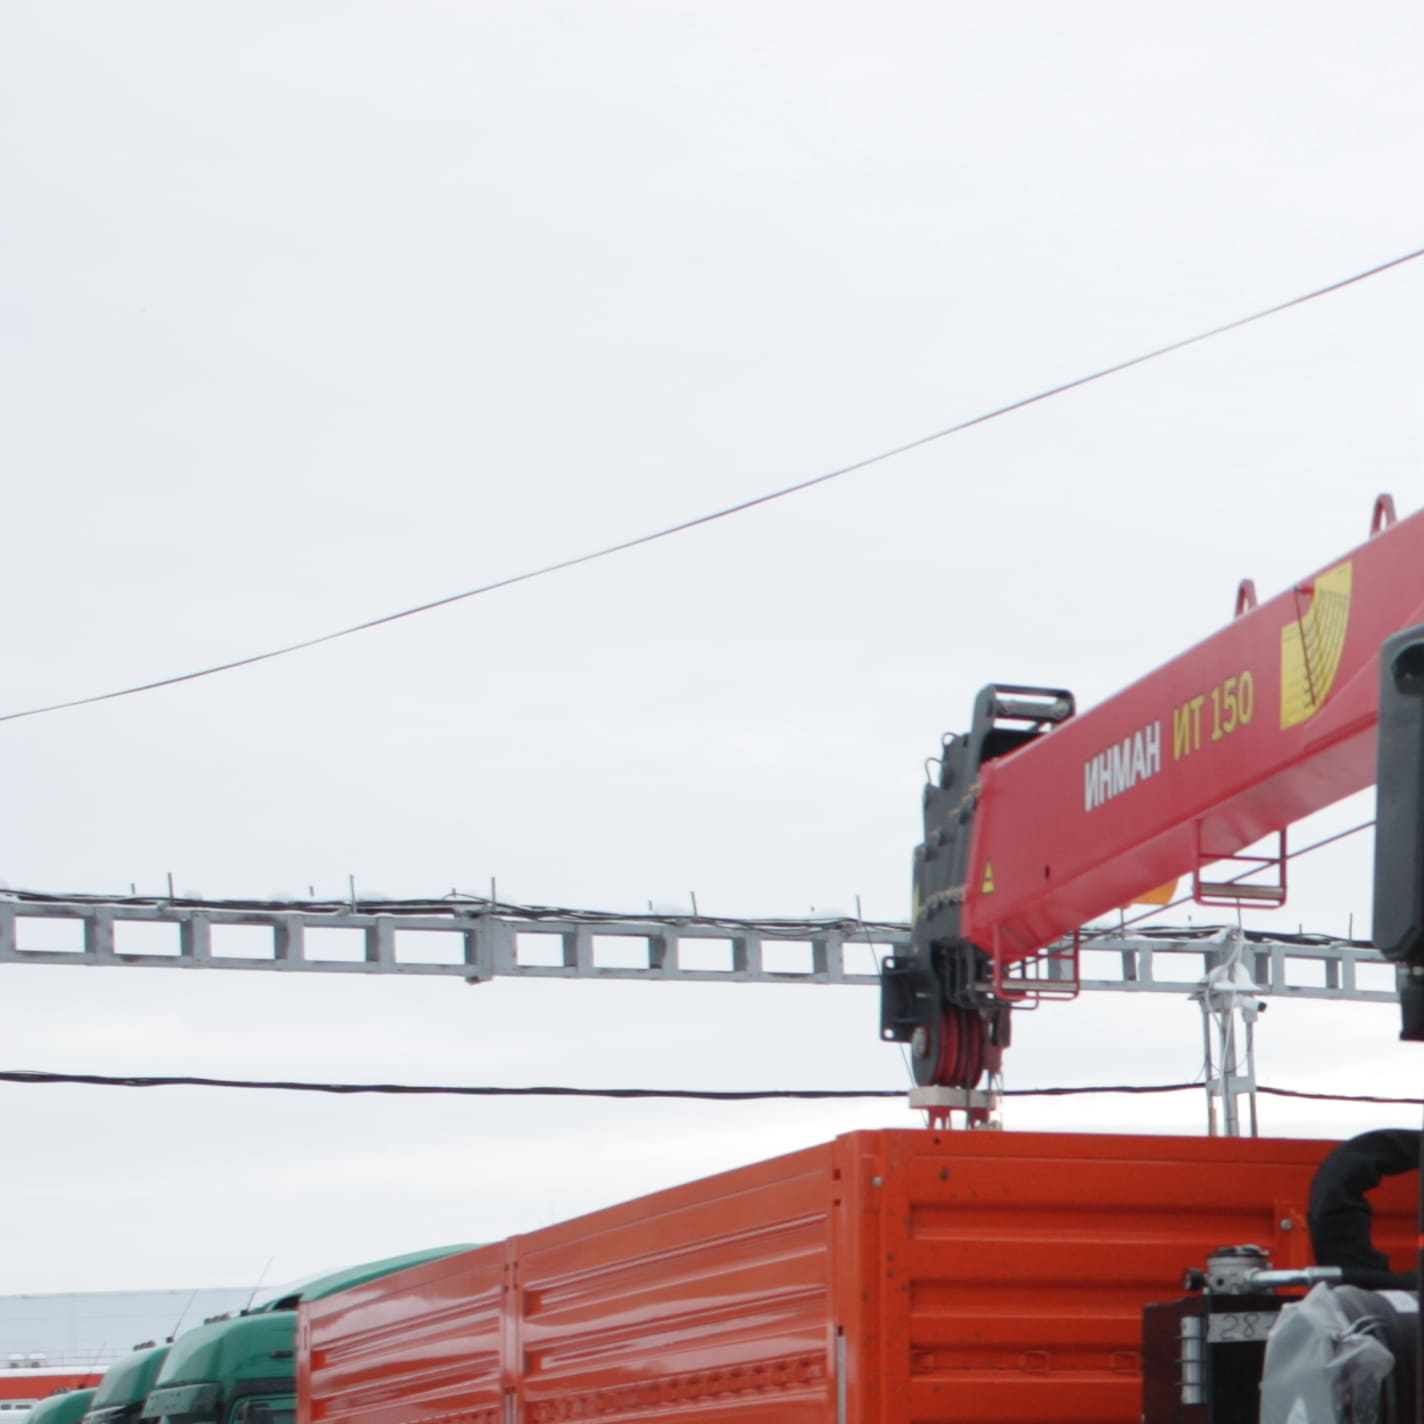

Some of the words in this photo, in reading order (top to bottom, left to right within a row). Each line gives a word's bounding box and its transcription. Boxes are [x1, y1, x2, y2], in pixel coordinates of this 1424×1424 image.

[1084, 720, 1161, 813] ИНМАН
[1173, 695, 1205, 762] ИТ
[1211, 670, 1254, 741] 150
